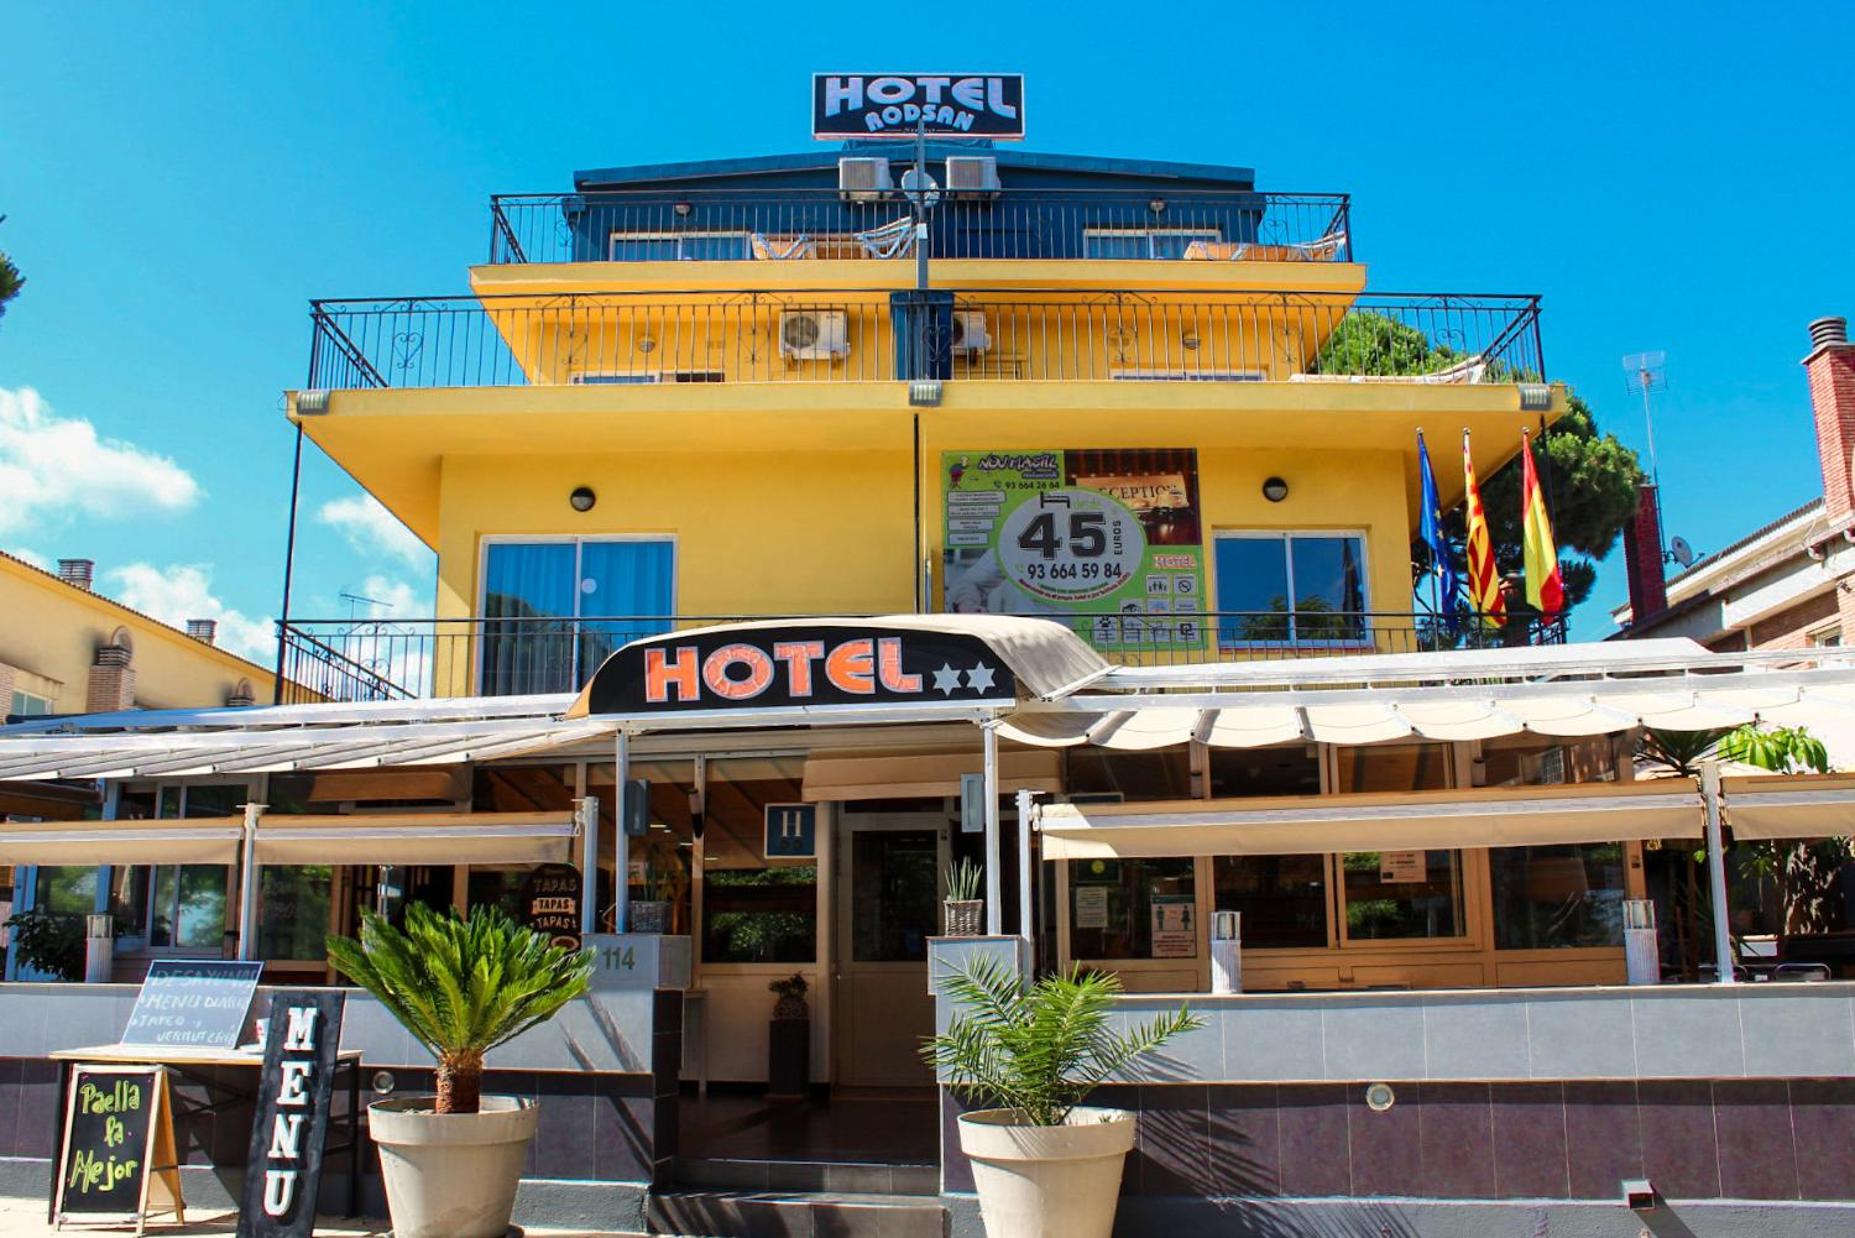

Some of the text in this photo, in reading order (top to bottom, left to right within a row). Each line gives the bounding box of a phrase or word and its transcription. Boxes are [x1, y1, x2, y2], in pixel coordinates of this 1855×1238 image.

[825, 77, 1016, 119] HOTEL
[864, 103, 975, 132] RODSAN
[1005, 481, 1016, 489] 93
[1018, 481, 1034, 489] 664
[1018, 512, 1106, 560] 45
[1113, 520, 1122, 555] EUROS
[1027, 562, 1121, 579] 93 664 59 84
[644, 637, 923, 703] HOTEL
[533, 879, 576, 892] TAPAS
[539, 898, 570, 910] TAPAS
[602, 945, 635, 970] 114
[80, 1080, 140, 1113] Paella
[263, 1007, 319, 1217] MENU
[104, 1115, 124, 1148] la
[70, 1150, 138, 1194] Mejor
